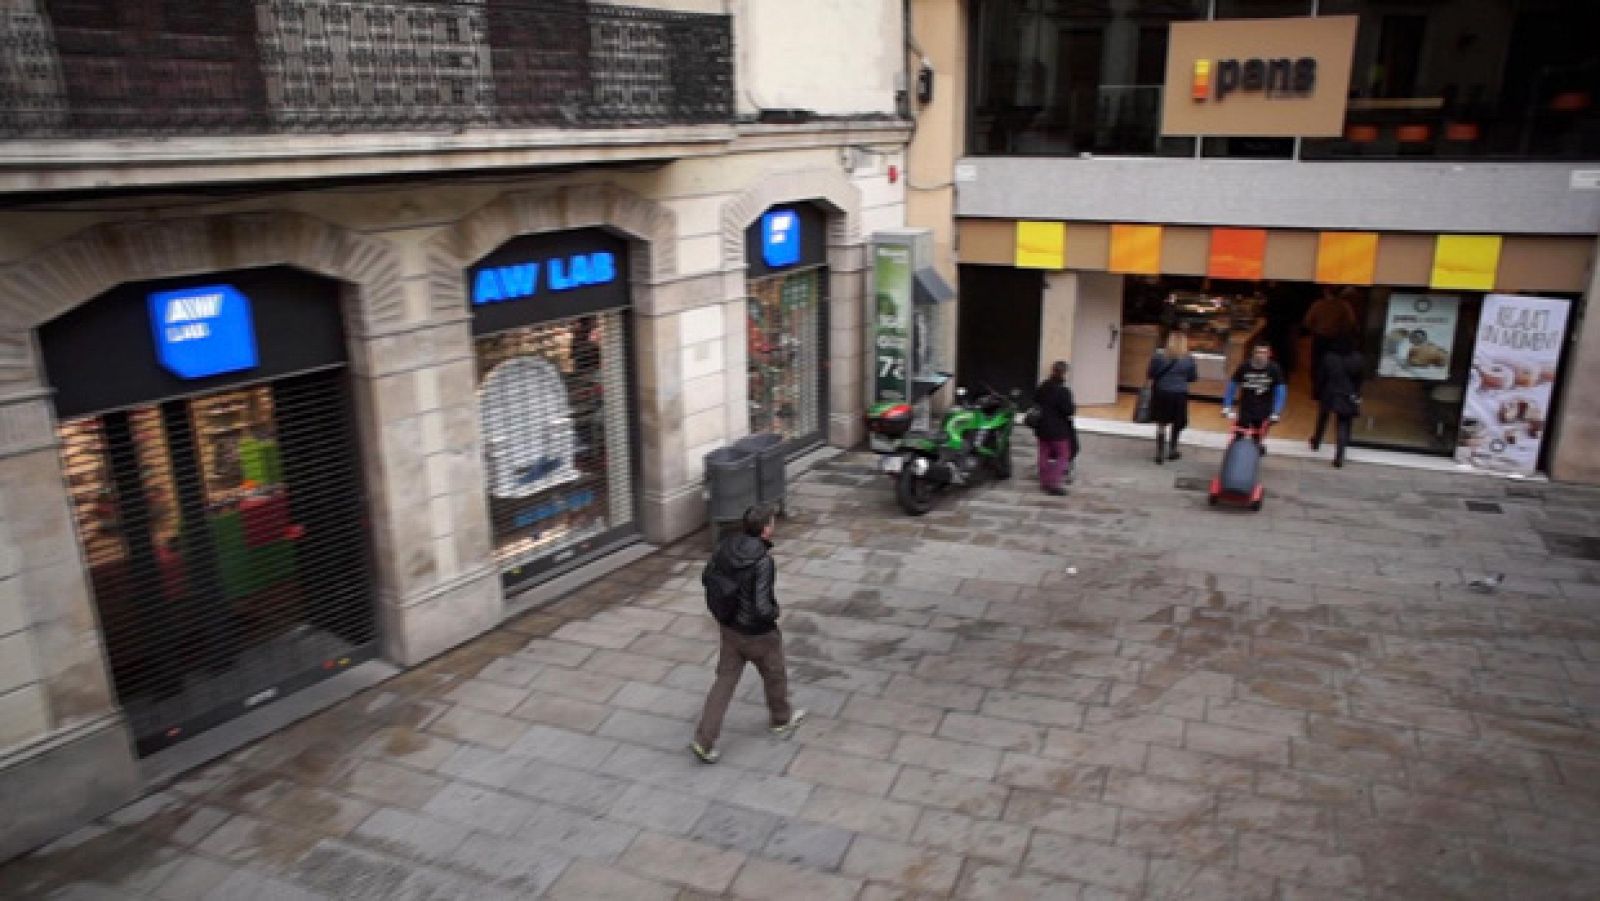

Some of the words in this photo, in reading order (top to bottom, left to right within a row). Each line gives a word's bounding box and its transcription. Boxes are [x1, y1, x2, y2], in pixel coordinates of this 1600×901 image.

[1215, 57, 1317, 102] pans
[473, 262, 540, 304] AW
[547, 251, 616, 290] LAB
